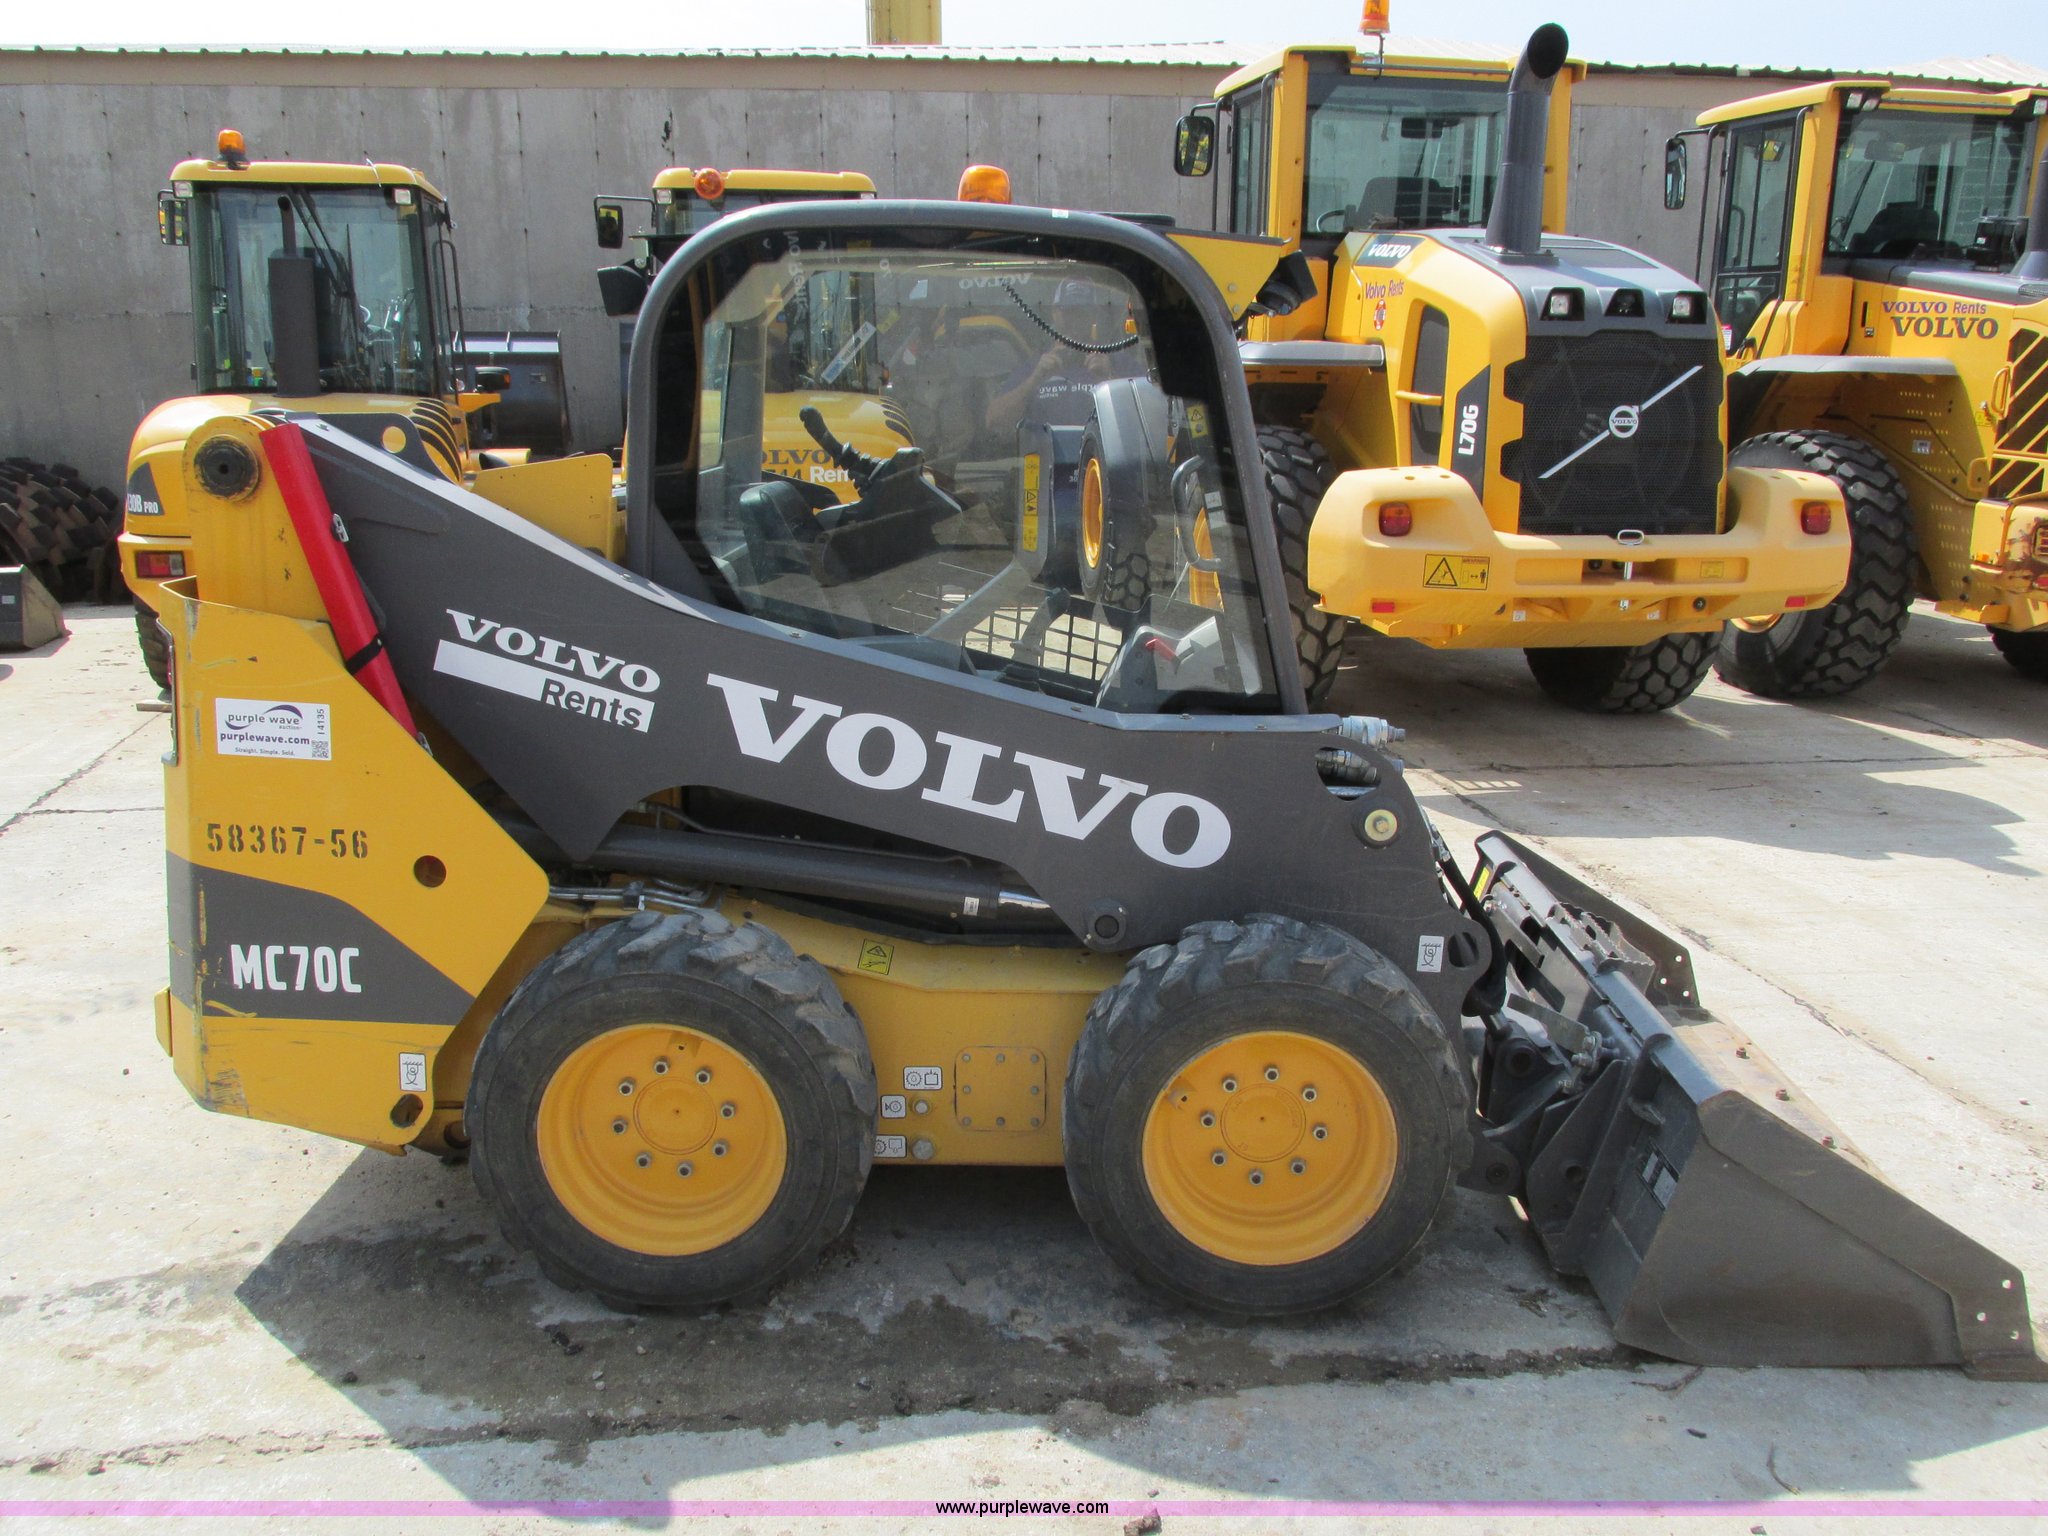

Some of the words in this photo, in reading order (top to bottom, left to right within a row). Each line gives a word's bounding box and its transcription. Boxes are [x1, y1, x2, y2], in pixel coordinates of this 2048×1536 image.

[1368, 243, 1411, 259] VOLVO
[1365, 282, 1386, 299] Volvo
[1883, 301, 1948, 314] VOLVO
[1953, 301, 1987, 315] Rents
[1890, 316, 1999, 340] VOLVO
[1458, 405, 1479, 456] L70G
[760, 448, 832, 465] LVO
[810, 465, 856, 485] Ren
[143, 501, 159, 514] PRO
[446, 608, 661, 693] VOLVO
[540, 677, 642, 731] Rents
[228, 713, 265, 725] purple
[316, 708, 325, 735] 14135
[220, 732, 310, 745] purplewave.com
[235, 746, 258, 755] Straight.
[260, 748, 280, 756] Simple.
[706, 673, 1232, 869] VOLVO
[207, 823, 368, 859] 58367-56
[230, 944, 362, 993] MC70C
